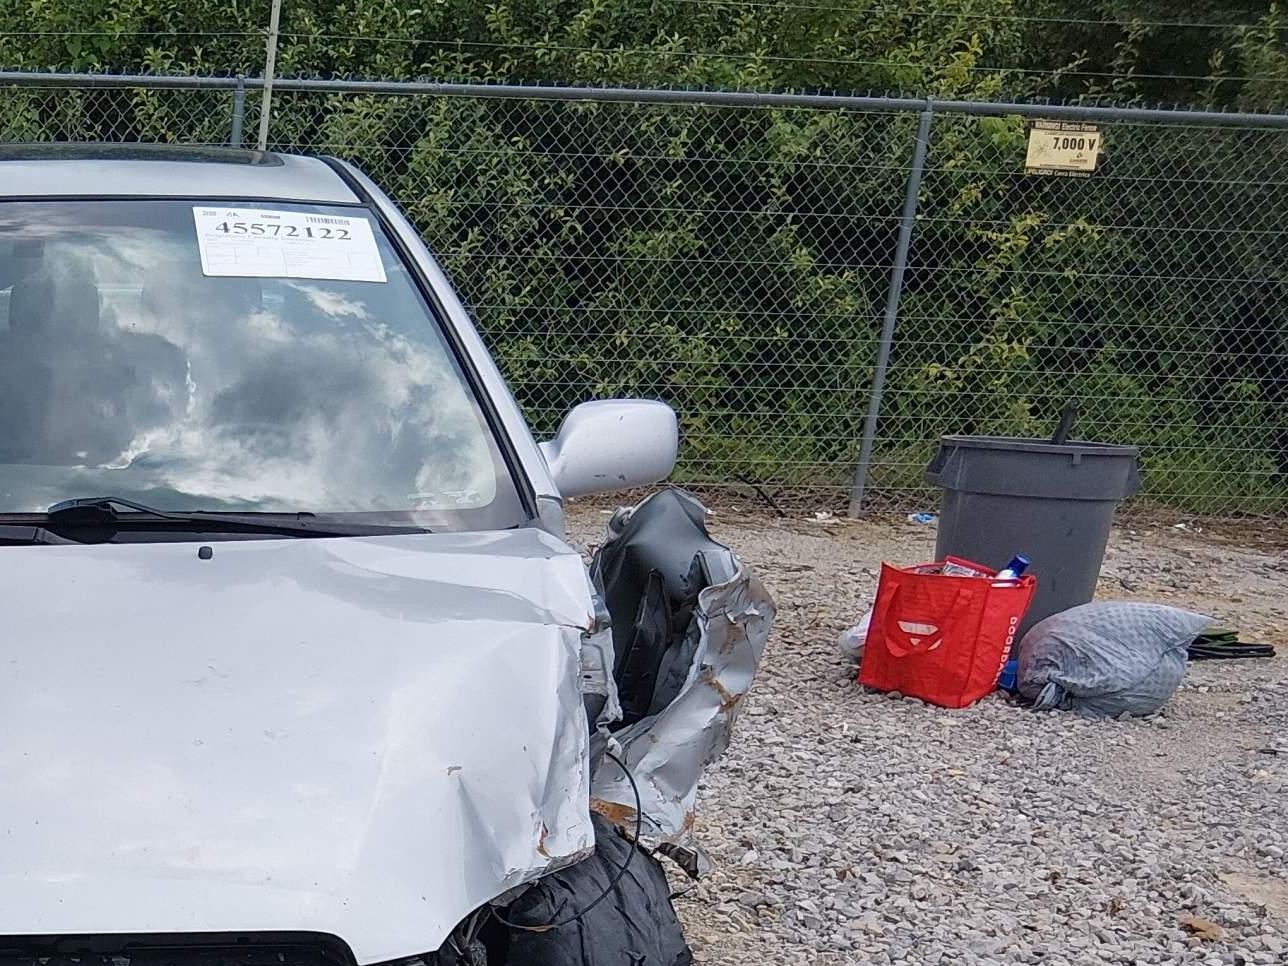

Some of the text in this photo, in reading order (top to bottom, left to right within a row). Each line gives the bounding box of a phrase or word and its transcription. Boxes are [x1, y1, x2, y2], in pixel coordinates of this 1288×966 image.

[1053, 137, 1096, 151] 7,000 V
[215, 221, 352, 240] 45572122
